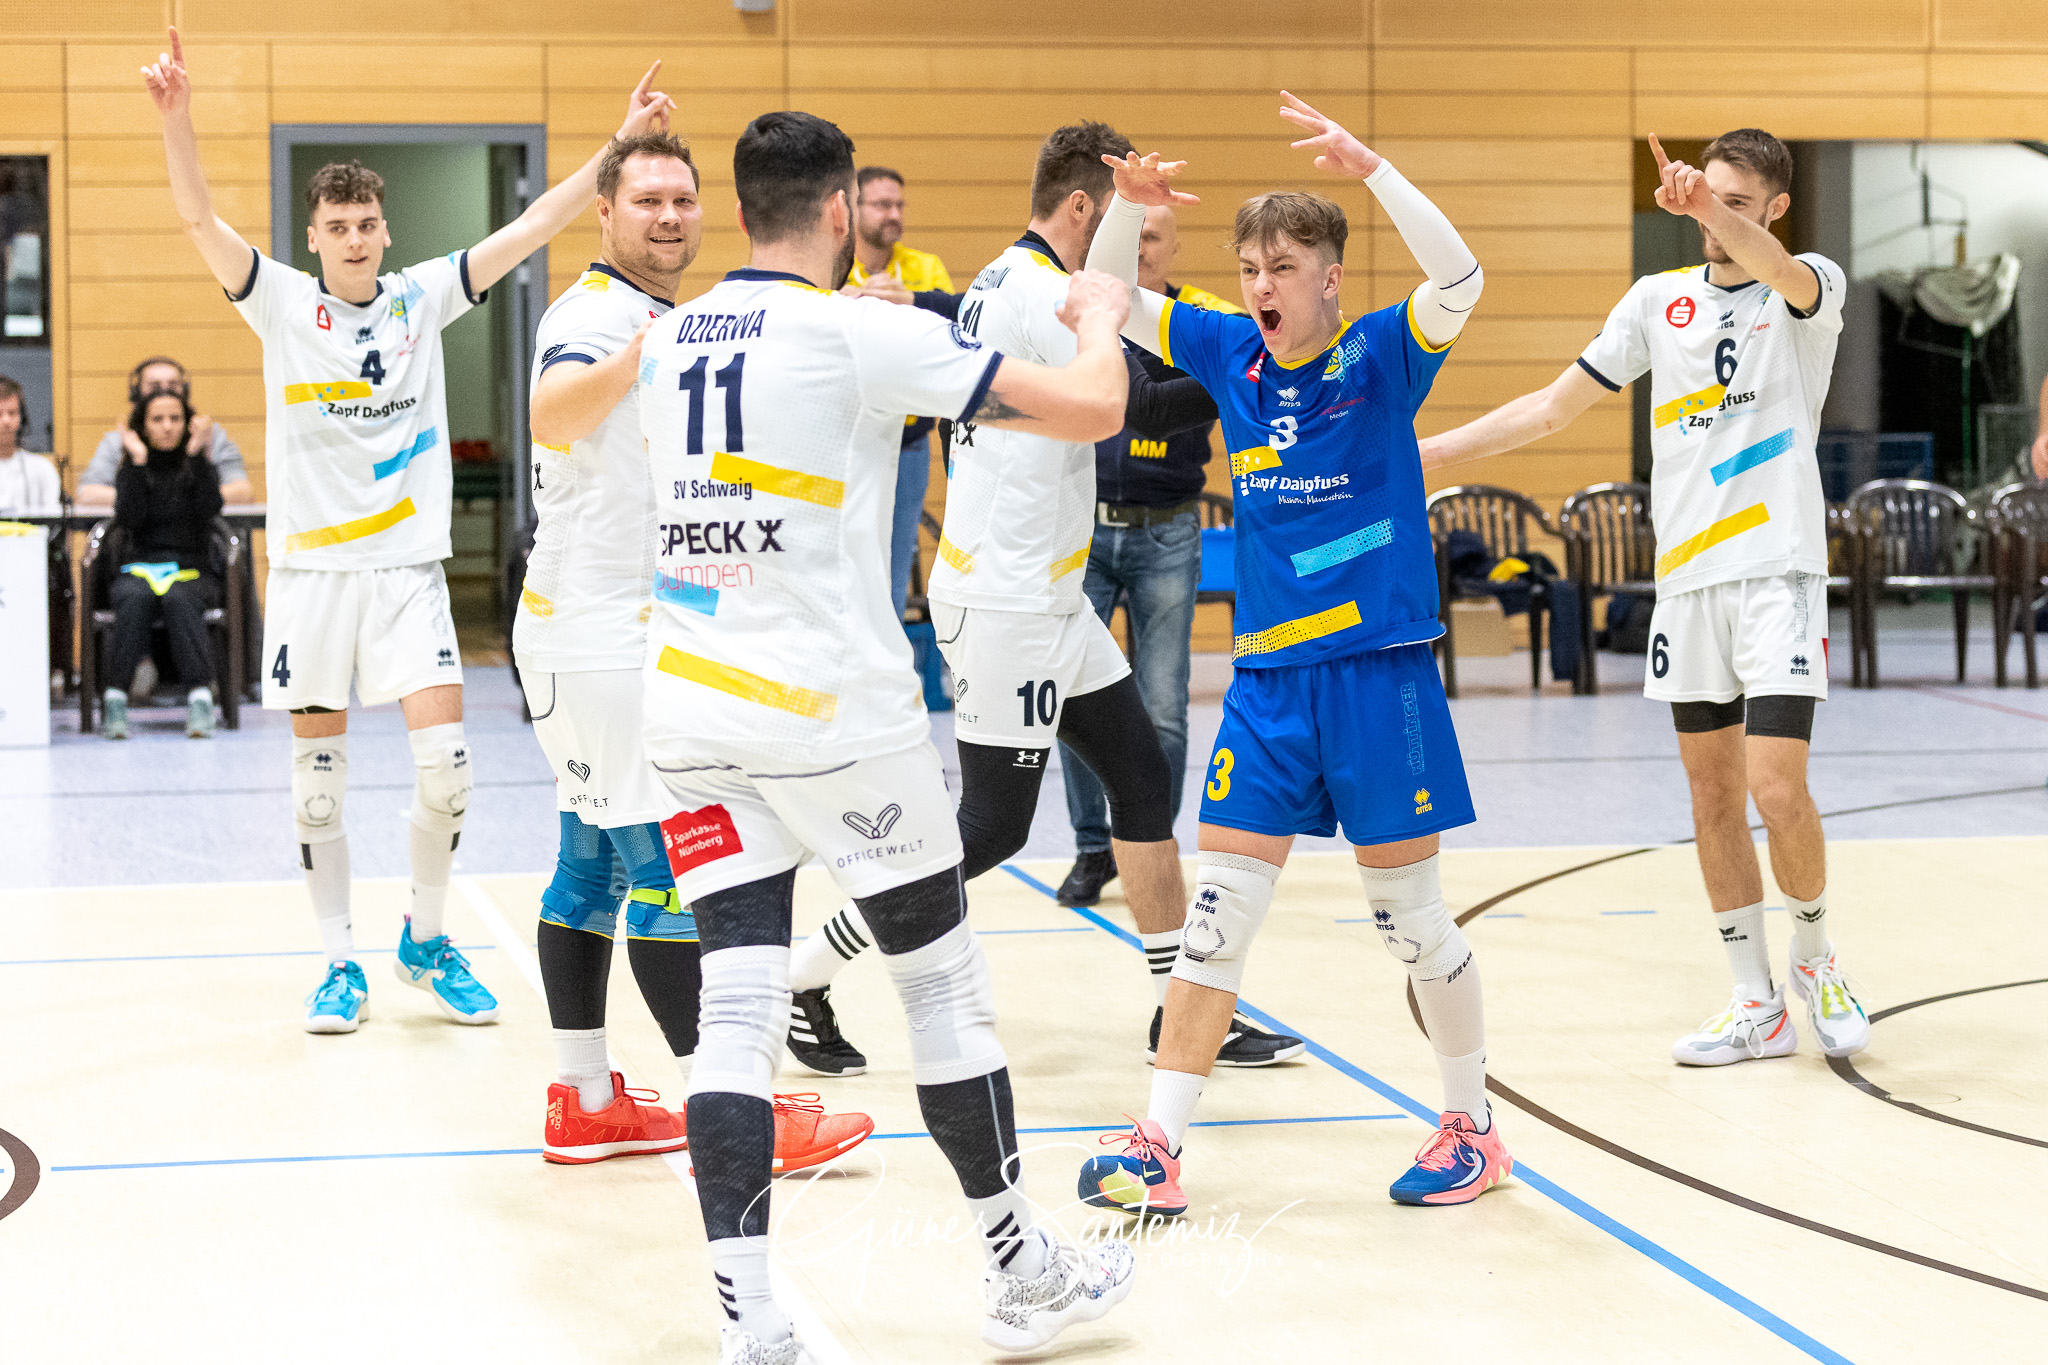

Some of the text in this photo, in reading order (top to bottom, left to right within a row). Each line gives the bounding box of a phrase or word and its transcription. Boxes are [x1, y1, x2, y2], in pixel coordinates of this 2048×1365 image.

[677, 309, 766, 344] DZIERWA
[360, 349, 387, 386] 4
[1715, 338, 1738, 387] 6
[328, 396, 417, 418] Zapf Dagfuss
[678, 352, 746, 455] 11
[1268, 415, 1299, 450] 3
[1688, 415, 1714, 430] Zap
[1129, 438, 1168, 458] MM
[674, 477, 753, 501] SV Schwaig
[1249, 473, 1350, 493] Zapf Daigfuss
[271, 644, 291, 688] 4
[1652, 633, 1670, 679] 6
[1016, 679, 1058, 727] 10
[1206, 747, 1235, 802] 3
[673, 822, 722, 845] Sparkasse
[678, 835, 724, 858] Nürnberg
[837, 839, 924, 868] OFFICEWELT
[554, 1096, 564, 1130] adidas
